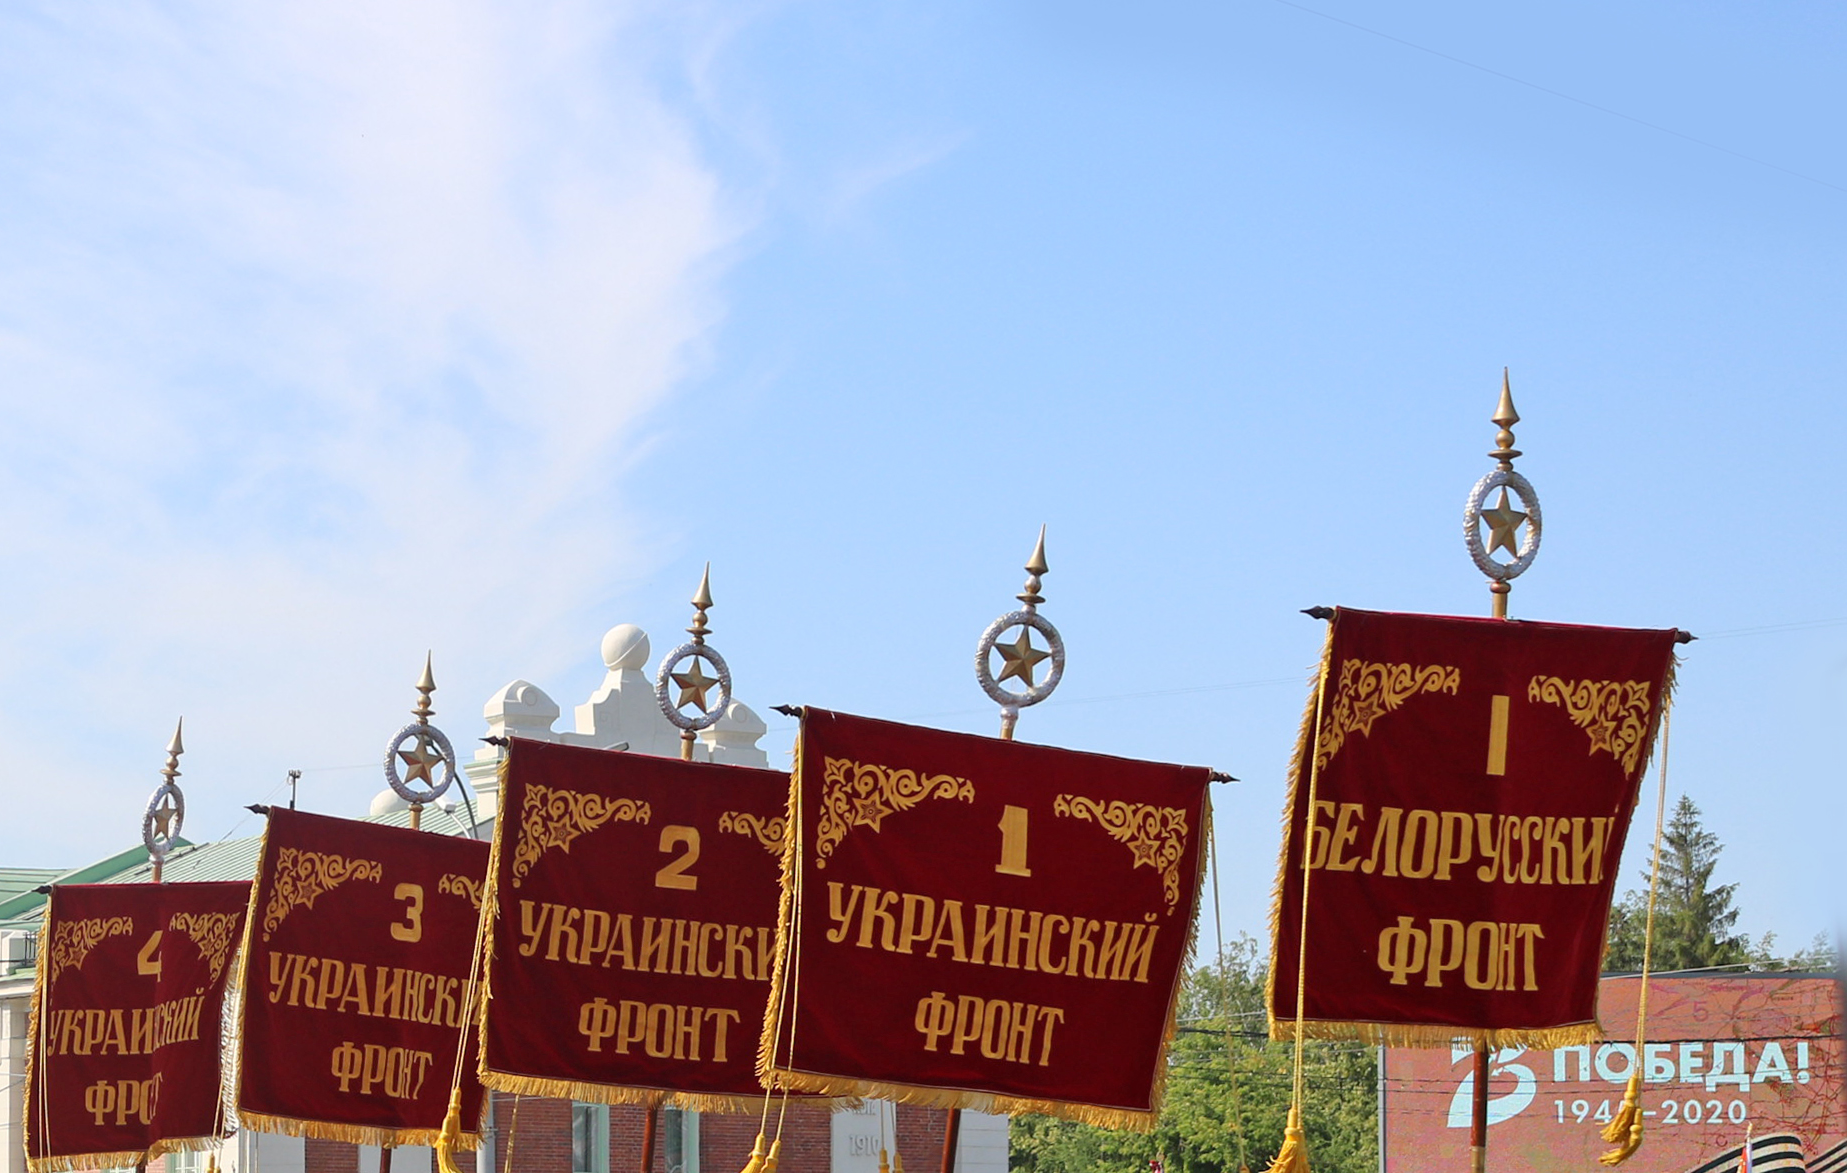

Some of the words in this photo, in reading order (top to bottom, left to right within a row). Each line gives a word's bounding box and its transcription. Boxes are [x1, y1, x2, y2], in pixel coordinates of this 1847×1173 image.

[655, 824, 701, 891] 2
[995, 804, 1031, 877] 1
[1300, 800, 1617, 885] БЕЛОРУССКИ
[390, 883, 424, 943] 3
[826, 881, 1160, 984] УКРАИНСКИЙ
[137, 930, 164, 983] 4
[1377, 916, 1545, 992] ФРОНТ
[578, 997, 741, 1063] ФРОНТ
[915, 990, 1065, 1067] ФРОНТ
[331, 1041, 433, 1100] ФРОНТ
[1553, 1041, 1811, 1093] ПОБЕДА!
[1554, 1099, 1747, 1125] 194–2020
